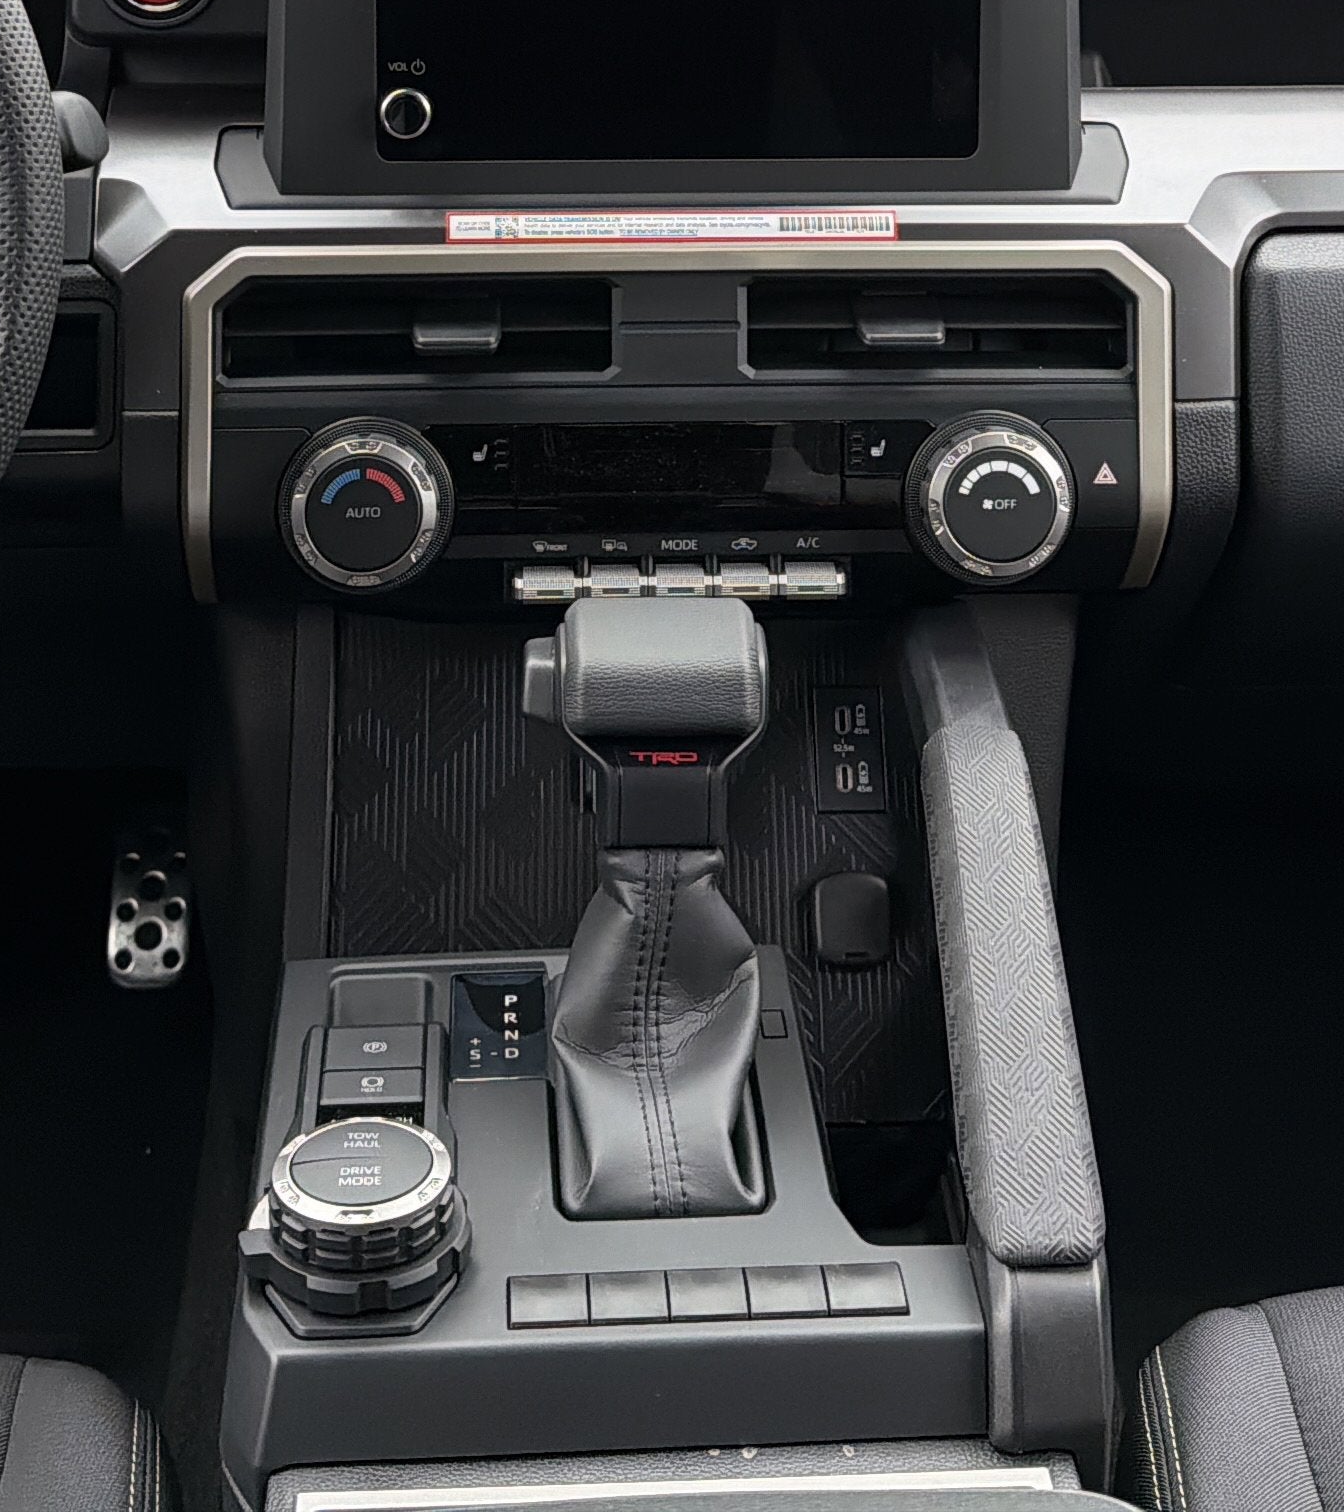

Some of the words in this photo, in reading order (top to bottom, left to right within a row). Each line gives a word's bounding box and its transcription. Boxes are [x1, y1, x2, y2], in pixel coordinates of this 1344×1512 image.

[387, 61, 409, 72] VOL
[994, 498, 1017, 510] OFF
[345, 506, 381, 519] AUTO
[546, 544, 568, 552] FRONT
[661, 539, 698, 551] MODE
[796, 537, 821, 549] A/C
[629, 751, 698, 765] TRD
[504, 994, 518, 1007] P
[503, 1012, 518, 1024] R
[504, 1029, 519, 1041] N
[469, 1048, 481, 1060] S
[504, 1047, 519, 1059] D
[347, 1132, 380, 1140] TOW
[343, 1140, 381, 1148] HAUL
[339, 1165, 382, 1176] DRIVE
[337, 1176, 382, 1187] MODE
